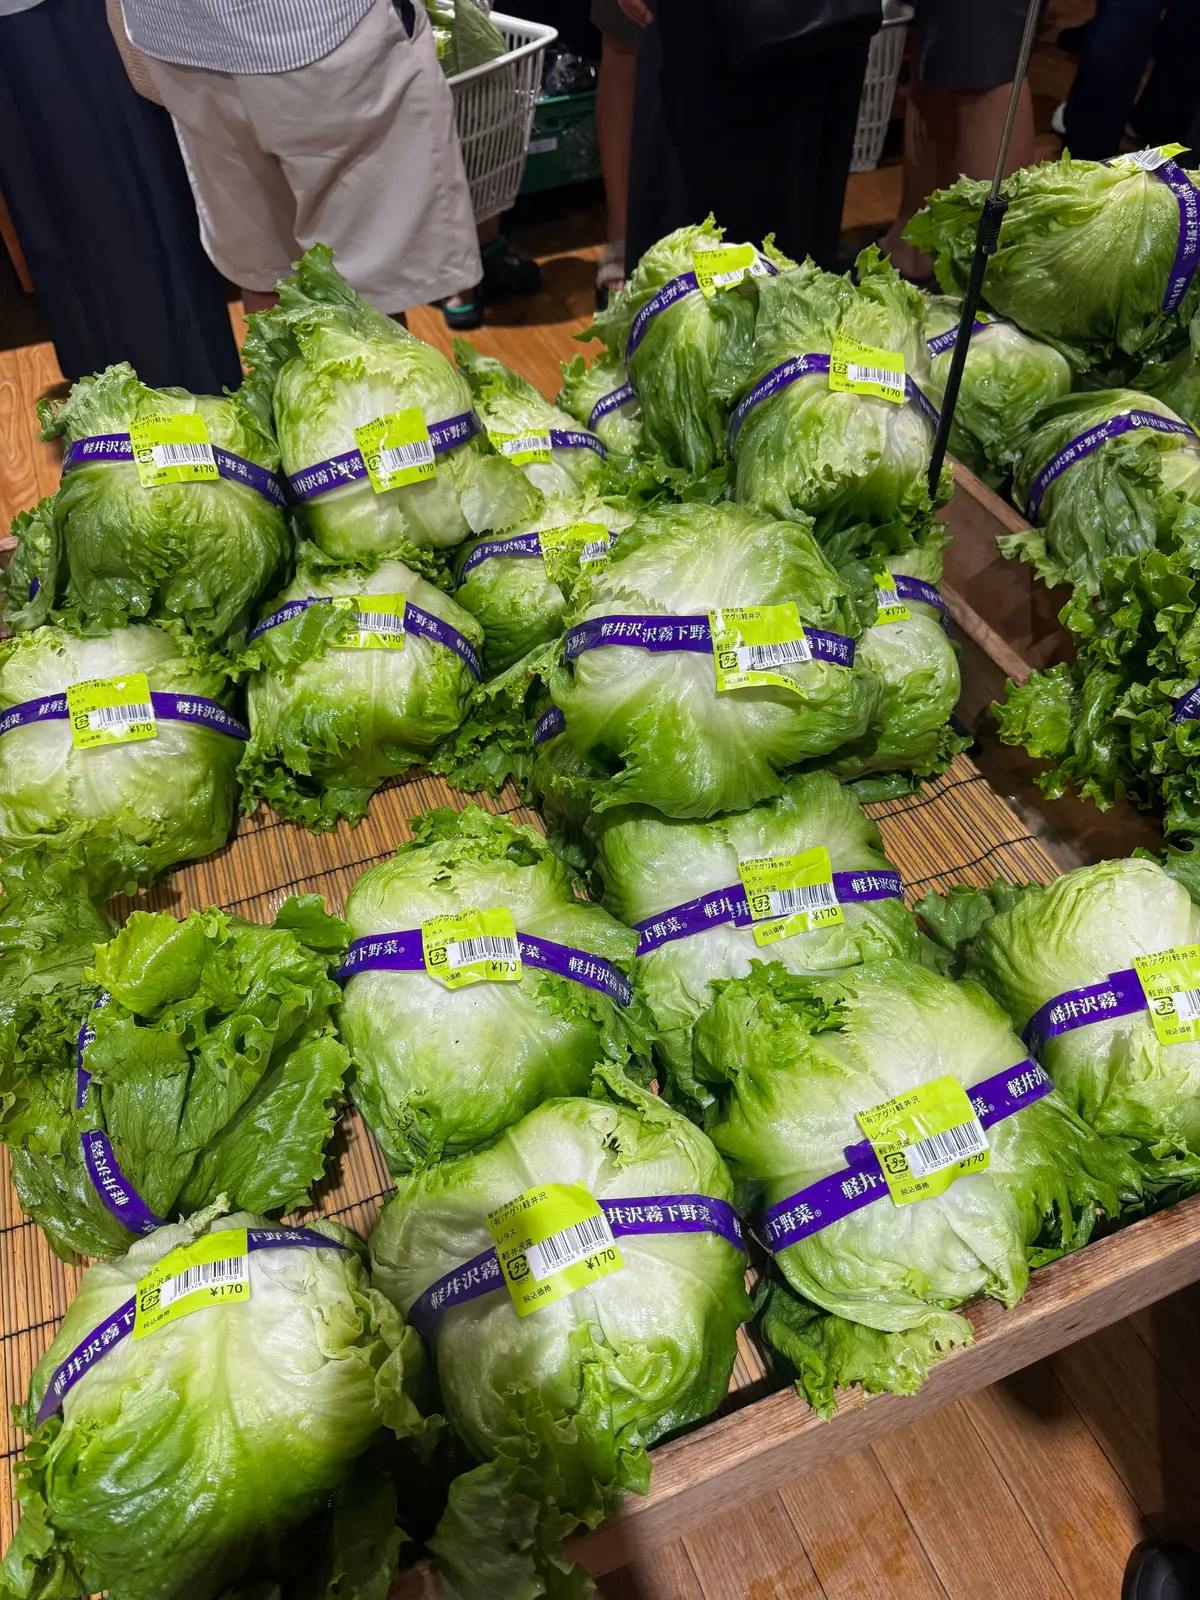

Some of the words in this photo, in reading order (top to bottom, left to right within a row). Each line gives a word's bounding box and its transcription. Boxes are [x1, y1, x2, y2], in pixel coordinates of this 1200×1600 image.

[881, 386, 901, 398] ¥170
[193, 465, 214, 474] ¥170
[417, 464, 434, 474] ¥170
[885, 605, 906, 617] ¥170
[382, 634, 401, 643] ¥170
[129, 723, 152, 734] ¥170
[812, 908, 838, 920] ¥170
[491, 961, 517, 972] ¥170
[1143, 973, 1165, 983] レタス
[862, 1095, 920, 1125] (有)アグリ軽井沢
[871, 1128, 893, 1140] レタス
[959, 1152, 985, 1169] ¥170
[900, 1182, 929, 1196] 税込価格
[490, 1191, 548, 1228] (有)アグリ軽井沢
[496, 1229, 517, 1245] レタス
[502, 1238, 535, 1261] 軽井沢産
[584, 1250, 616, 1271] ¥170
[210, 1283, 243, 1297] ¥170
[430, 1257, 500, 1310] 軽井沢霧
[523, 1285, 552, 1304] 税込価格
